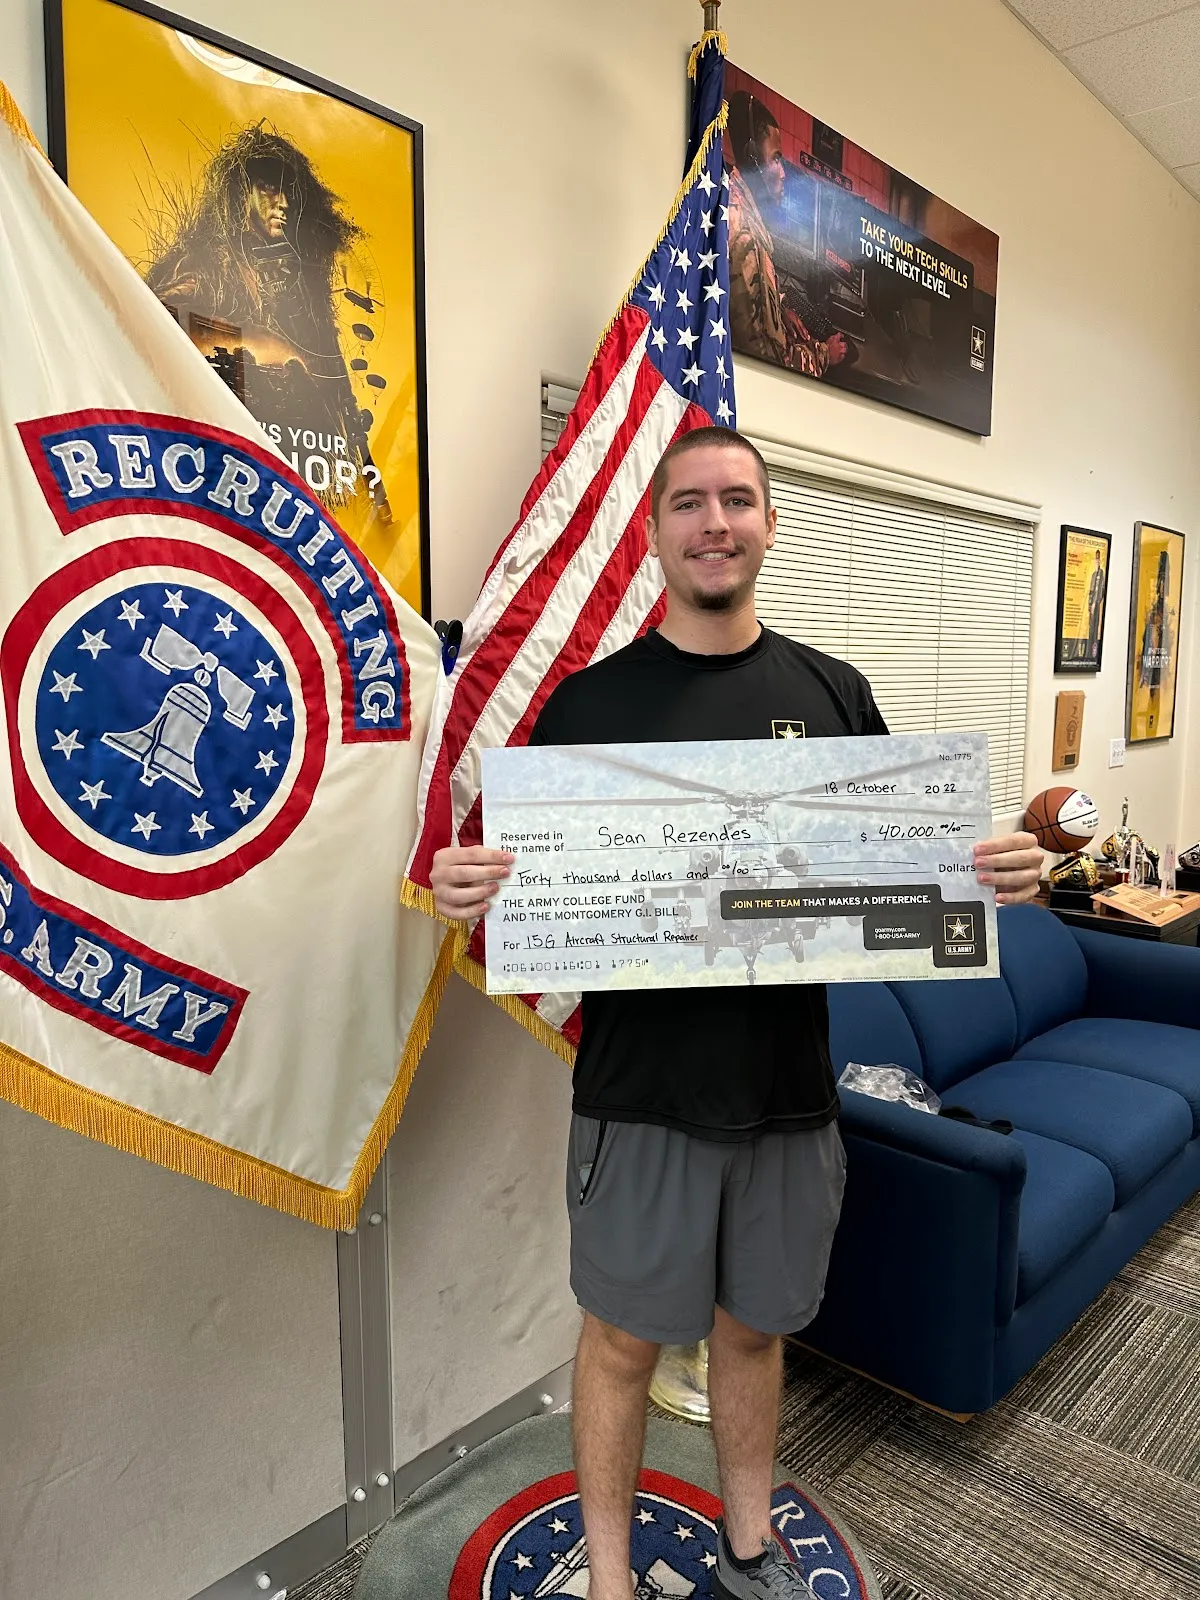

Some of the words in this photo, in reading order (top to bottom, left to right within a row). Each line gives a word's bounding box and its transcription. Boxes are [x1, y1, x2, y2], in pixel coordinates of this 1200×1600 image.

[860, 216, 887, 245] TAKE
[888, 231, 914, 260] YOUR
[915, 247, 938, 273] TECH
[939, 261, 968, 289] SKILLS
[860, 237, 873, 258] TO
[874, 245, 894, 270] THE
[896, 257, 920, 283] NEXT
[921, 270, 951, 299] LEVEL.
[257, 421, 282, 444] 'S
[287, 426, 348, 455] YOUR
[50, 433, 396, 724] RECRUITING
[938, 753, 952, 761] No.
[954, 752, 972, 761] 1775
[824, 781, 838, 795] 18
[846, 781, 897, 794] October
[924, 784, 940, 794] 20
[943, 782, 957, 793] 22
[500, 831, 550, 842] Reserved
[553, 831, 564, 841] in
[597, 825, 646, 848] Sean
[662, 823, 752, 846] Rezendes
[860, 831, 868, 843] $
[500, 844, 518, 853] the
[521, 844, 551, 853] name
[553, 842, 565, 853] of
[938, 863, 976, 873] Dollars
[517, 868, 552, 888] Forty
[562, 869, 622, 884] thousand
[631, 868, 674, 882] dollars
[686, 866, 710, 880] and
[502, 898, 524, 909] THE
[527, 897, 560, 908] ARMY
[562, 895, 612, 906] COLLEGE
[615, 894, 645, 904] FUND
[731, 900, 753, 909] JOIN
[754, 899, 773, 908] THE
[775, 898, 801, 908] TEAM
[802, 898, 826, 907] THAT
[828, 896, 861, 906] MAKES
[863, 896, 869, 905] A
[871, 894, 932, 905] DIFFERENCE.
[502, 912, 527, 922] AND
[529, 911, 552, 921] THE
[554, 909, 632, 920] MONTGOMERY
[635, 908, 652, 918] G.I.
[654, 907, 679, 917] BILL
[503, 940, 520, 950] For
[526, 933, 556, 949] 15G
[564, 931, 606, 948] Aircraft
[610, 932, 659, 945] Structural
[663, 930, 699, 944] Repairer
[20, 918, 229, 1043] ARMY
